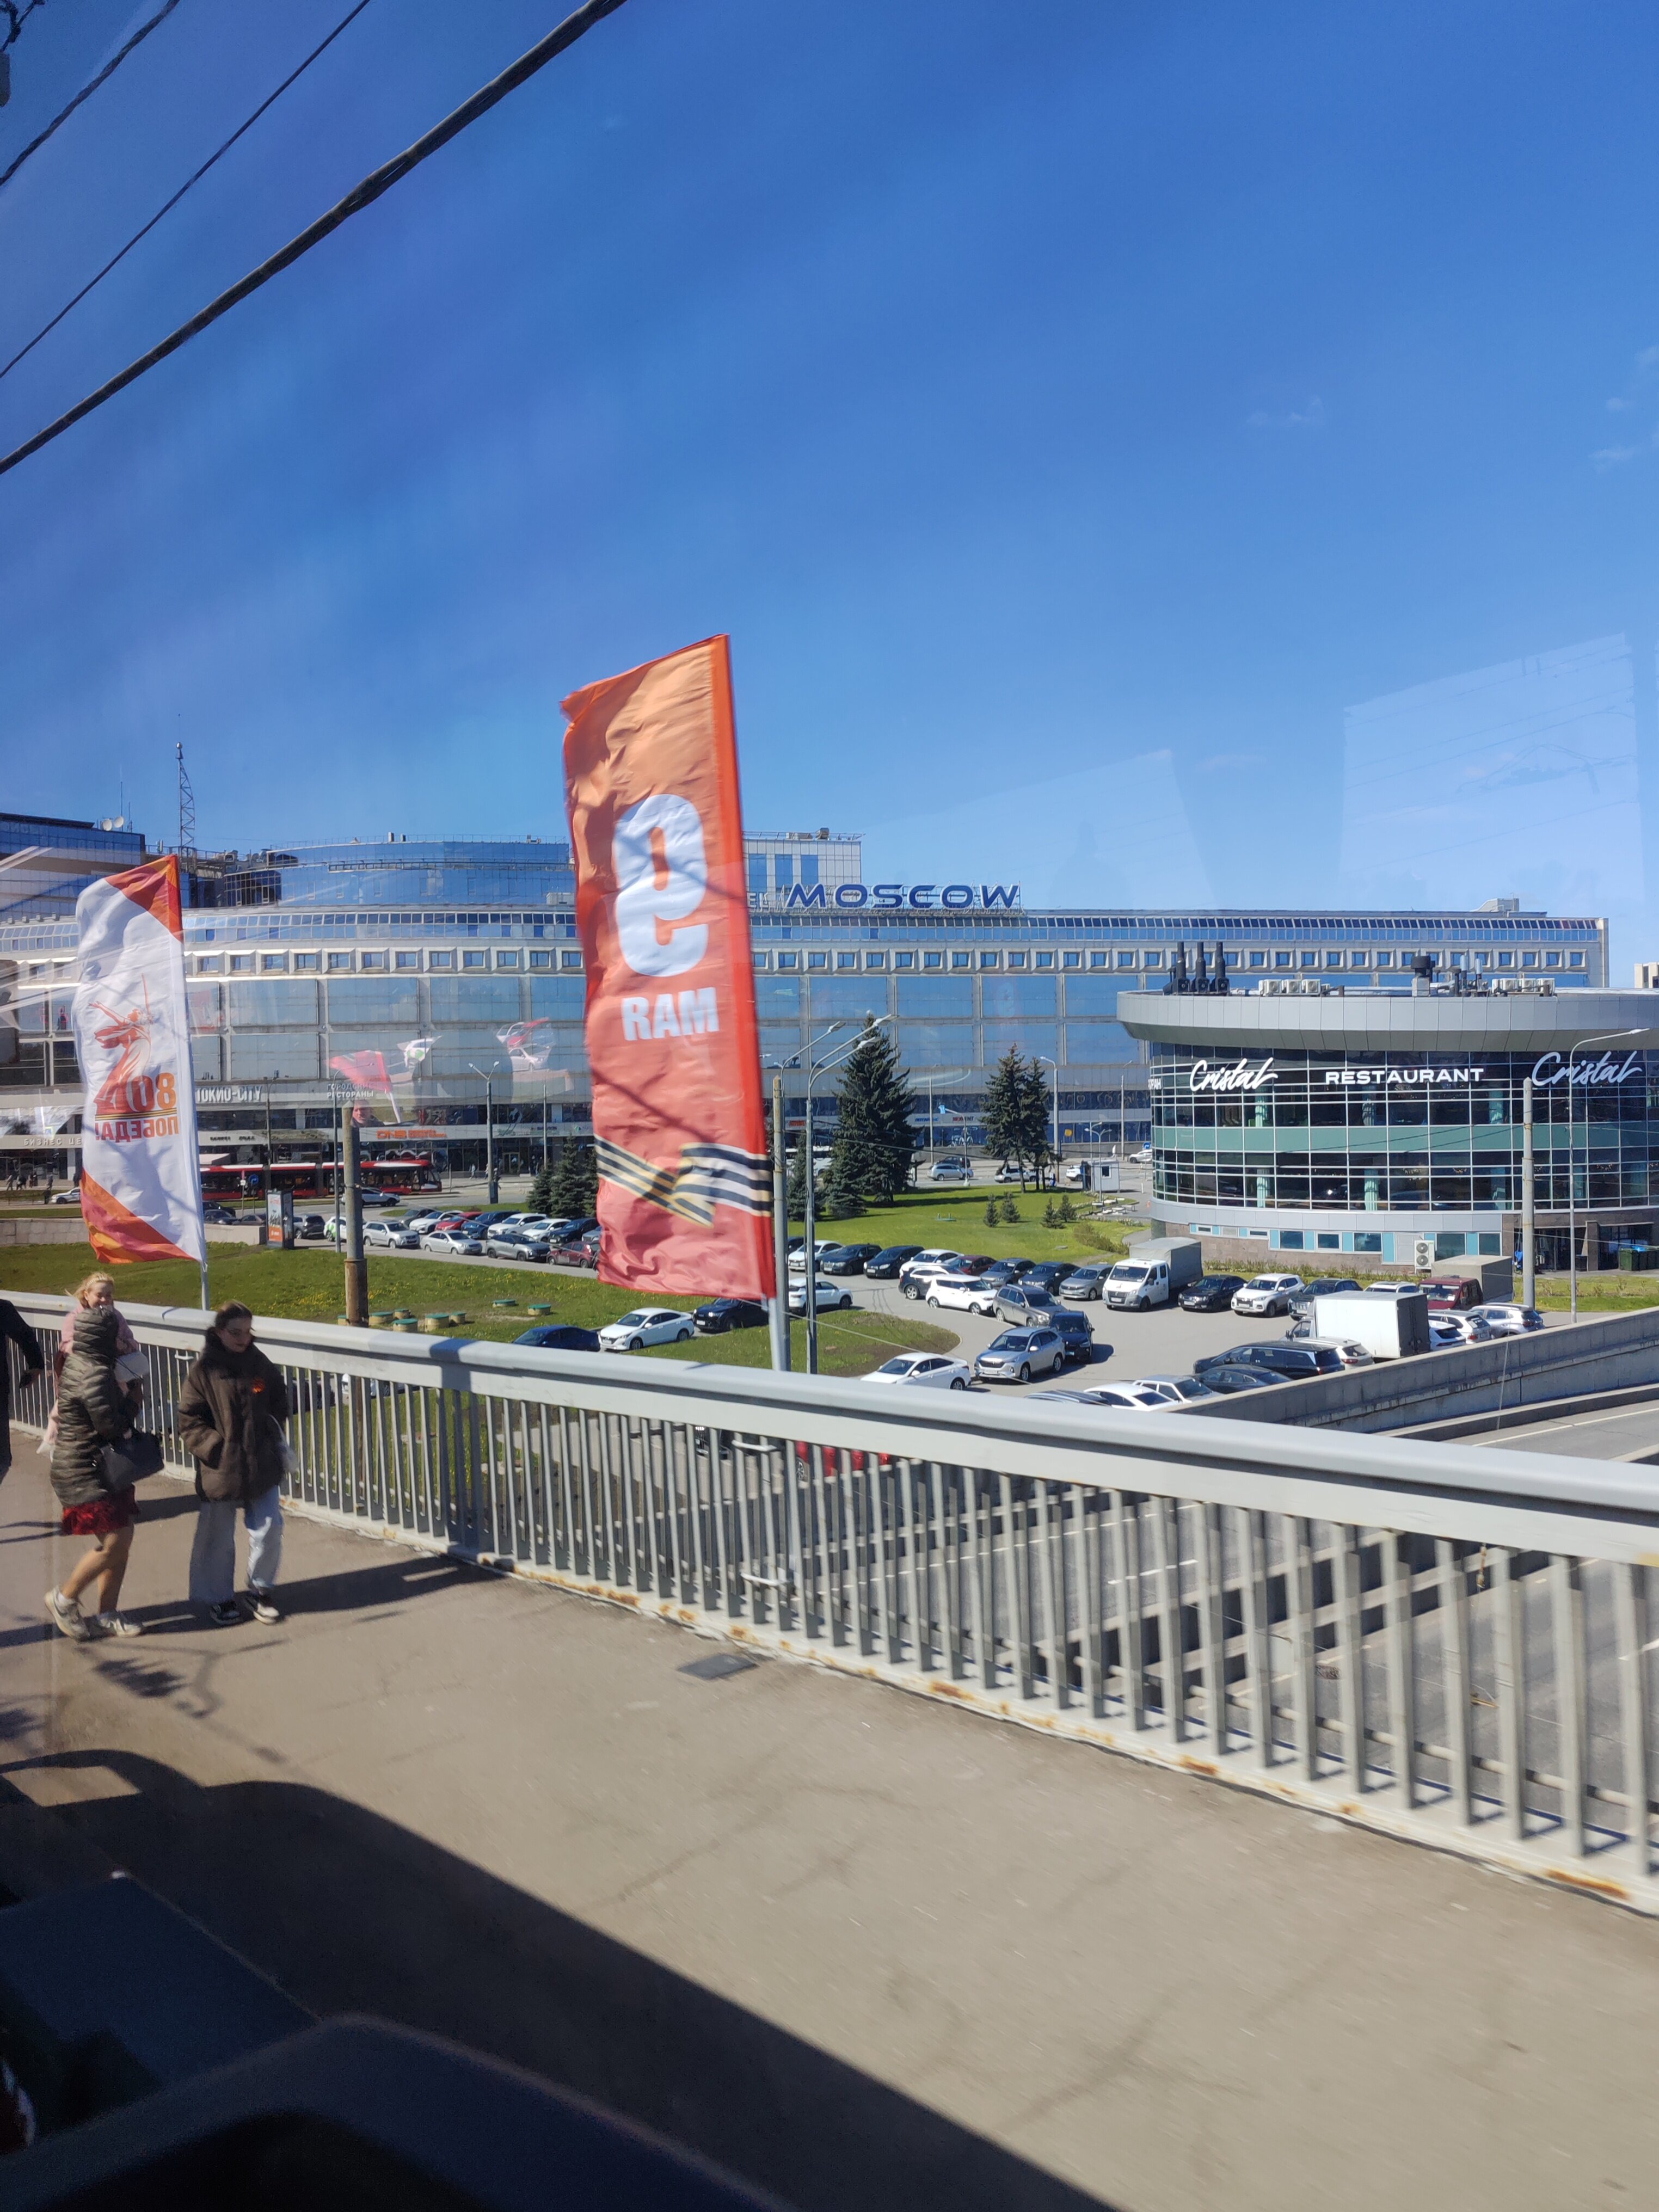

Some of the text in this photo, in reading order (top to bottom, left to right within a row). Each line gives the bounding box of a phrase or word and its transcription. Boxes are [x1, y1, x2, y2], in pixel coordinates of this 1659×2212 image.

[787, 882, 1019, 910] MOSCOW
[1190, 1057, 1278, 1091] Cristal
[1325, 1068, 1484, 1085] RESTAURANT
[1532, 1050, 1642, 1086] Cristal
[23, 1138, 63, 1146] БИЗНЕС
